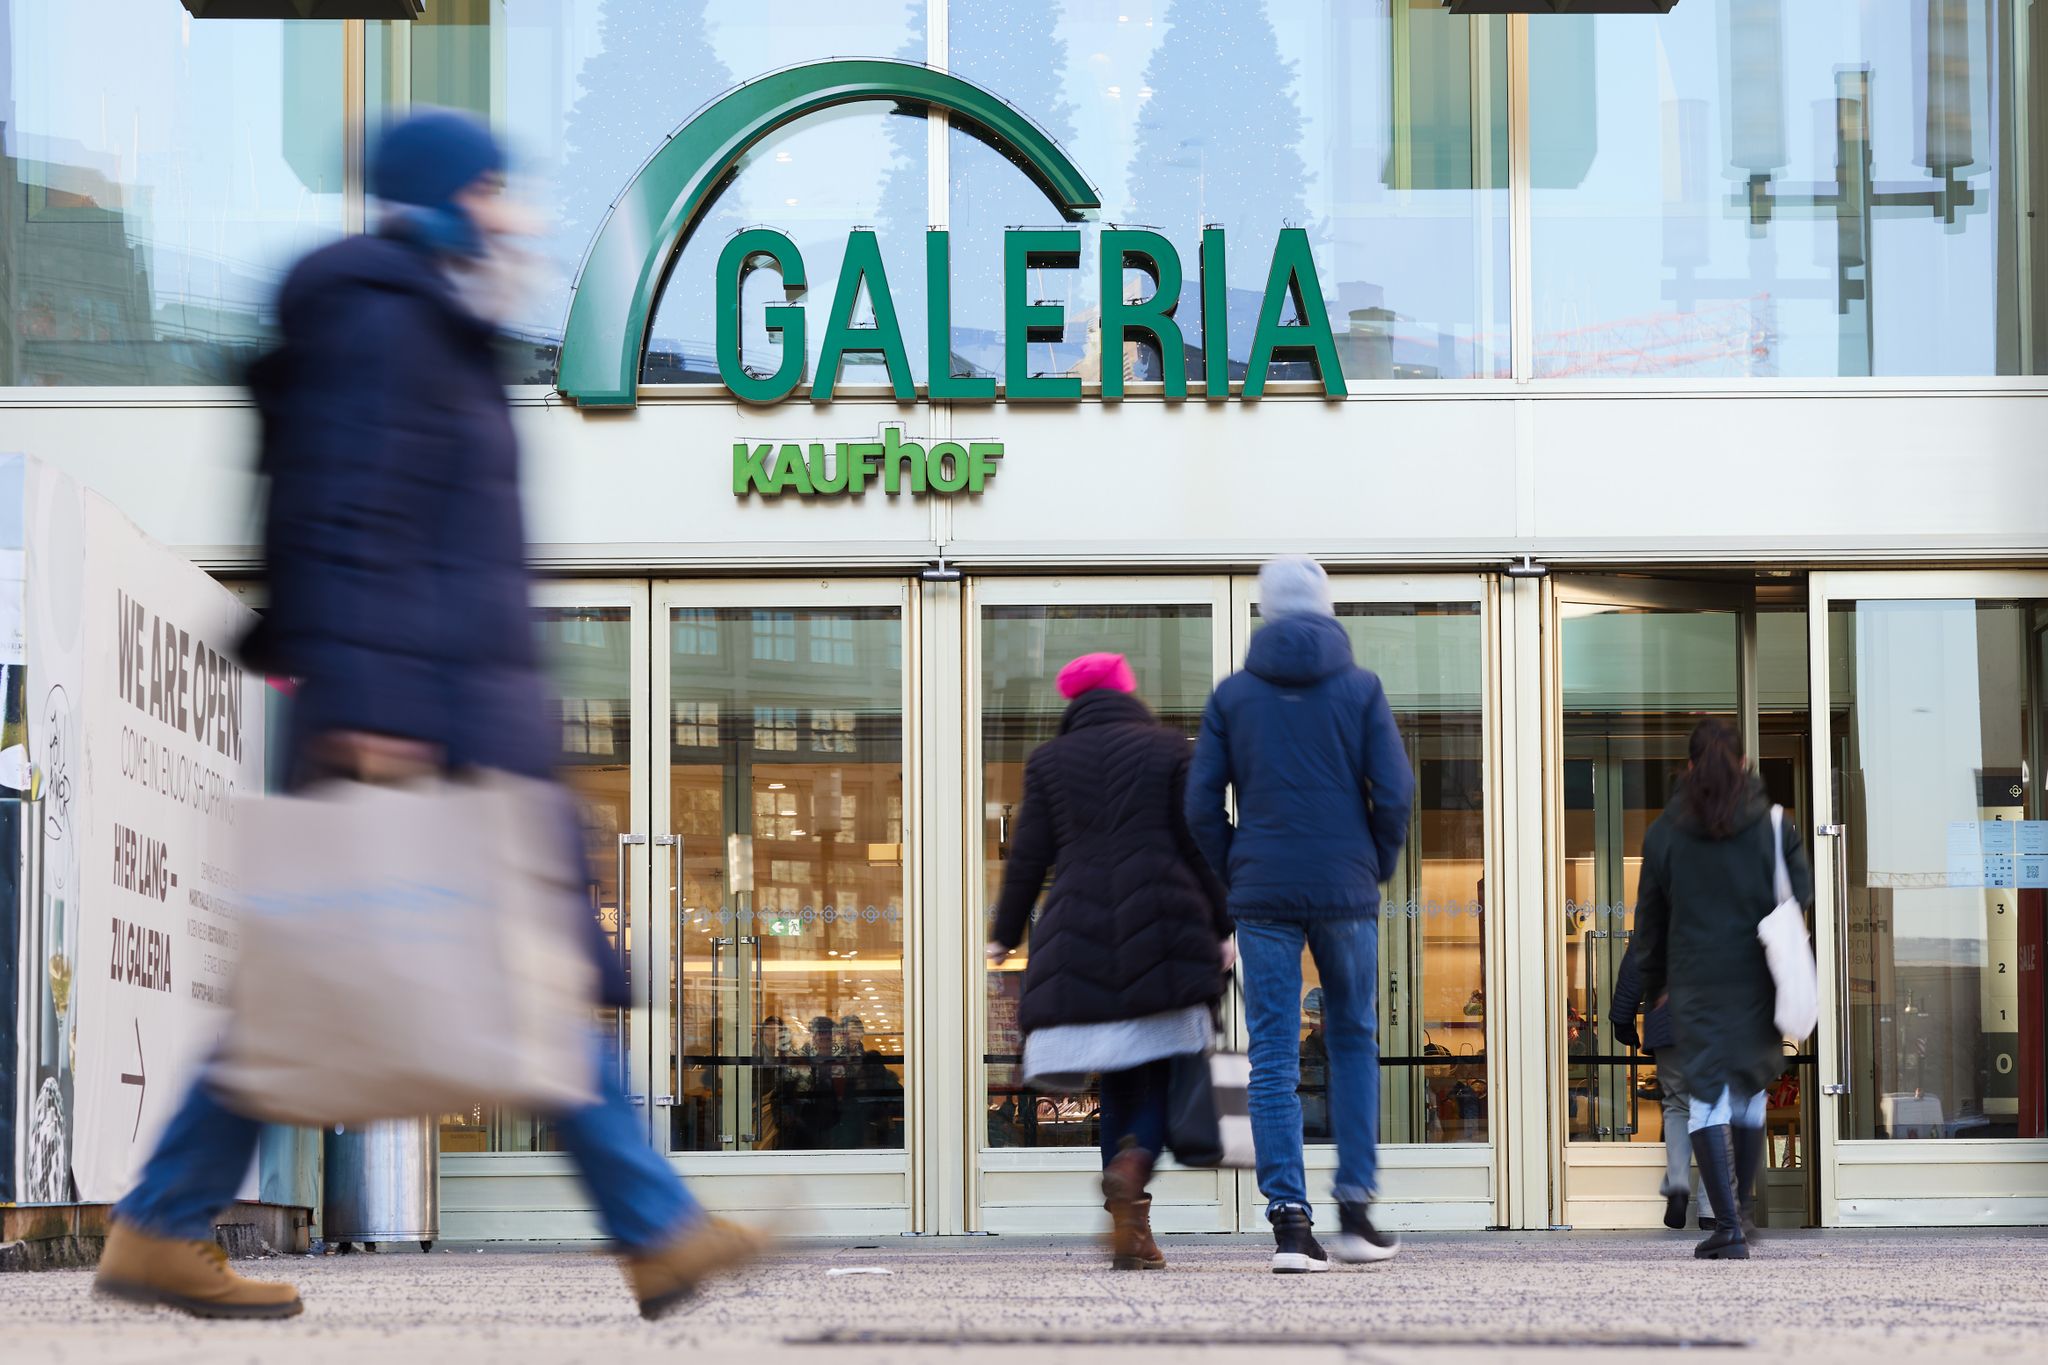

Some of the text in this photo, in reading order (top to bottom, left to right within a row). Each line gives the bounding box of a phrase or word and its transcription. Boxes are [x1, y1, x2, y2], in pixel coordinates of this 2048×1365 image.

[716, 228, 1348, 403] GALERIA
[117, 588, 243, 766] WE ARE OPEN!
[121, 725, 147, 786] COME
[162, 747, 193, 804] ENJOY
[113, 823, 136, 892] HIER
[139, 834, 168, 903] LANG
[1996, 903, 2005, 915] 3
[110, 917, 172, 993] ZU GALERIA
[1998, 963, 2006, 974] 2
[2019, 944, 2036, 971] SALE
[2000, 1010, 2006, 1021] 1
[1996, 1053, 2013, 1074] 0
